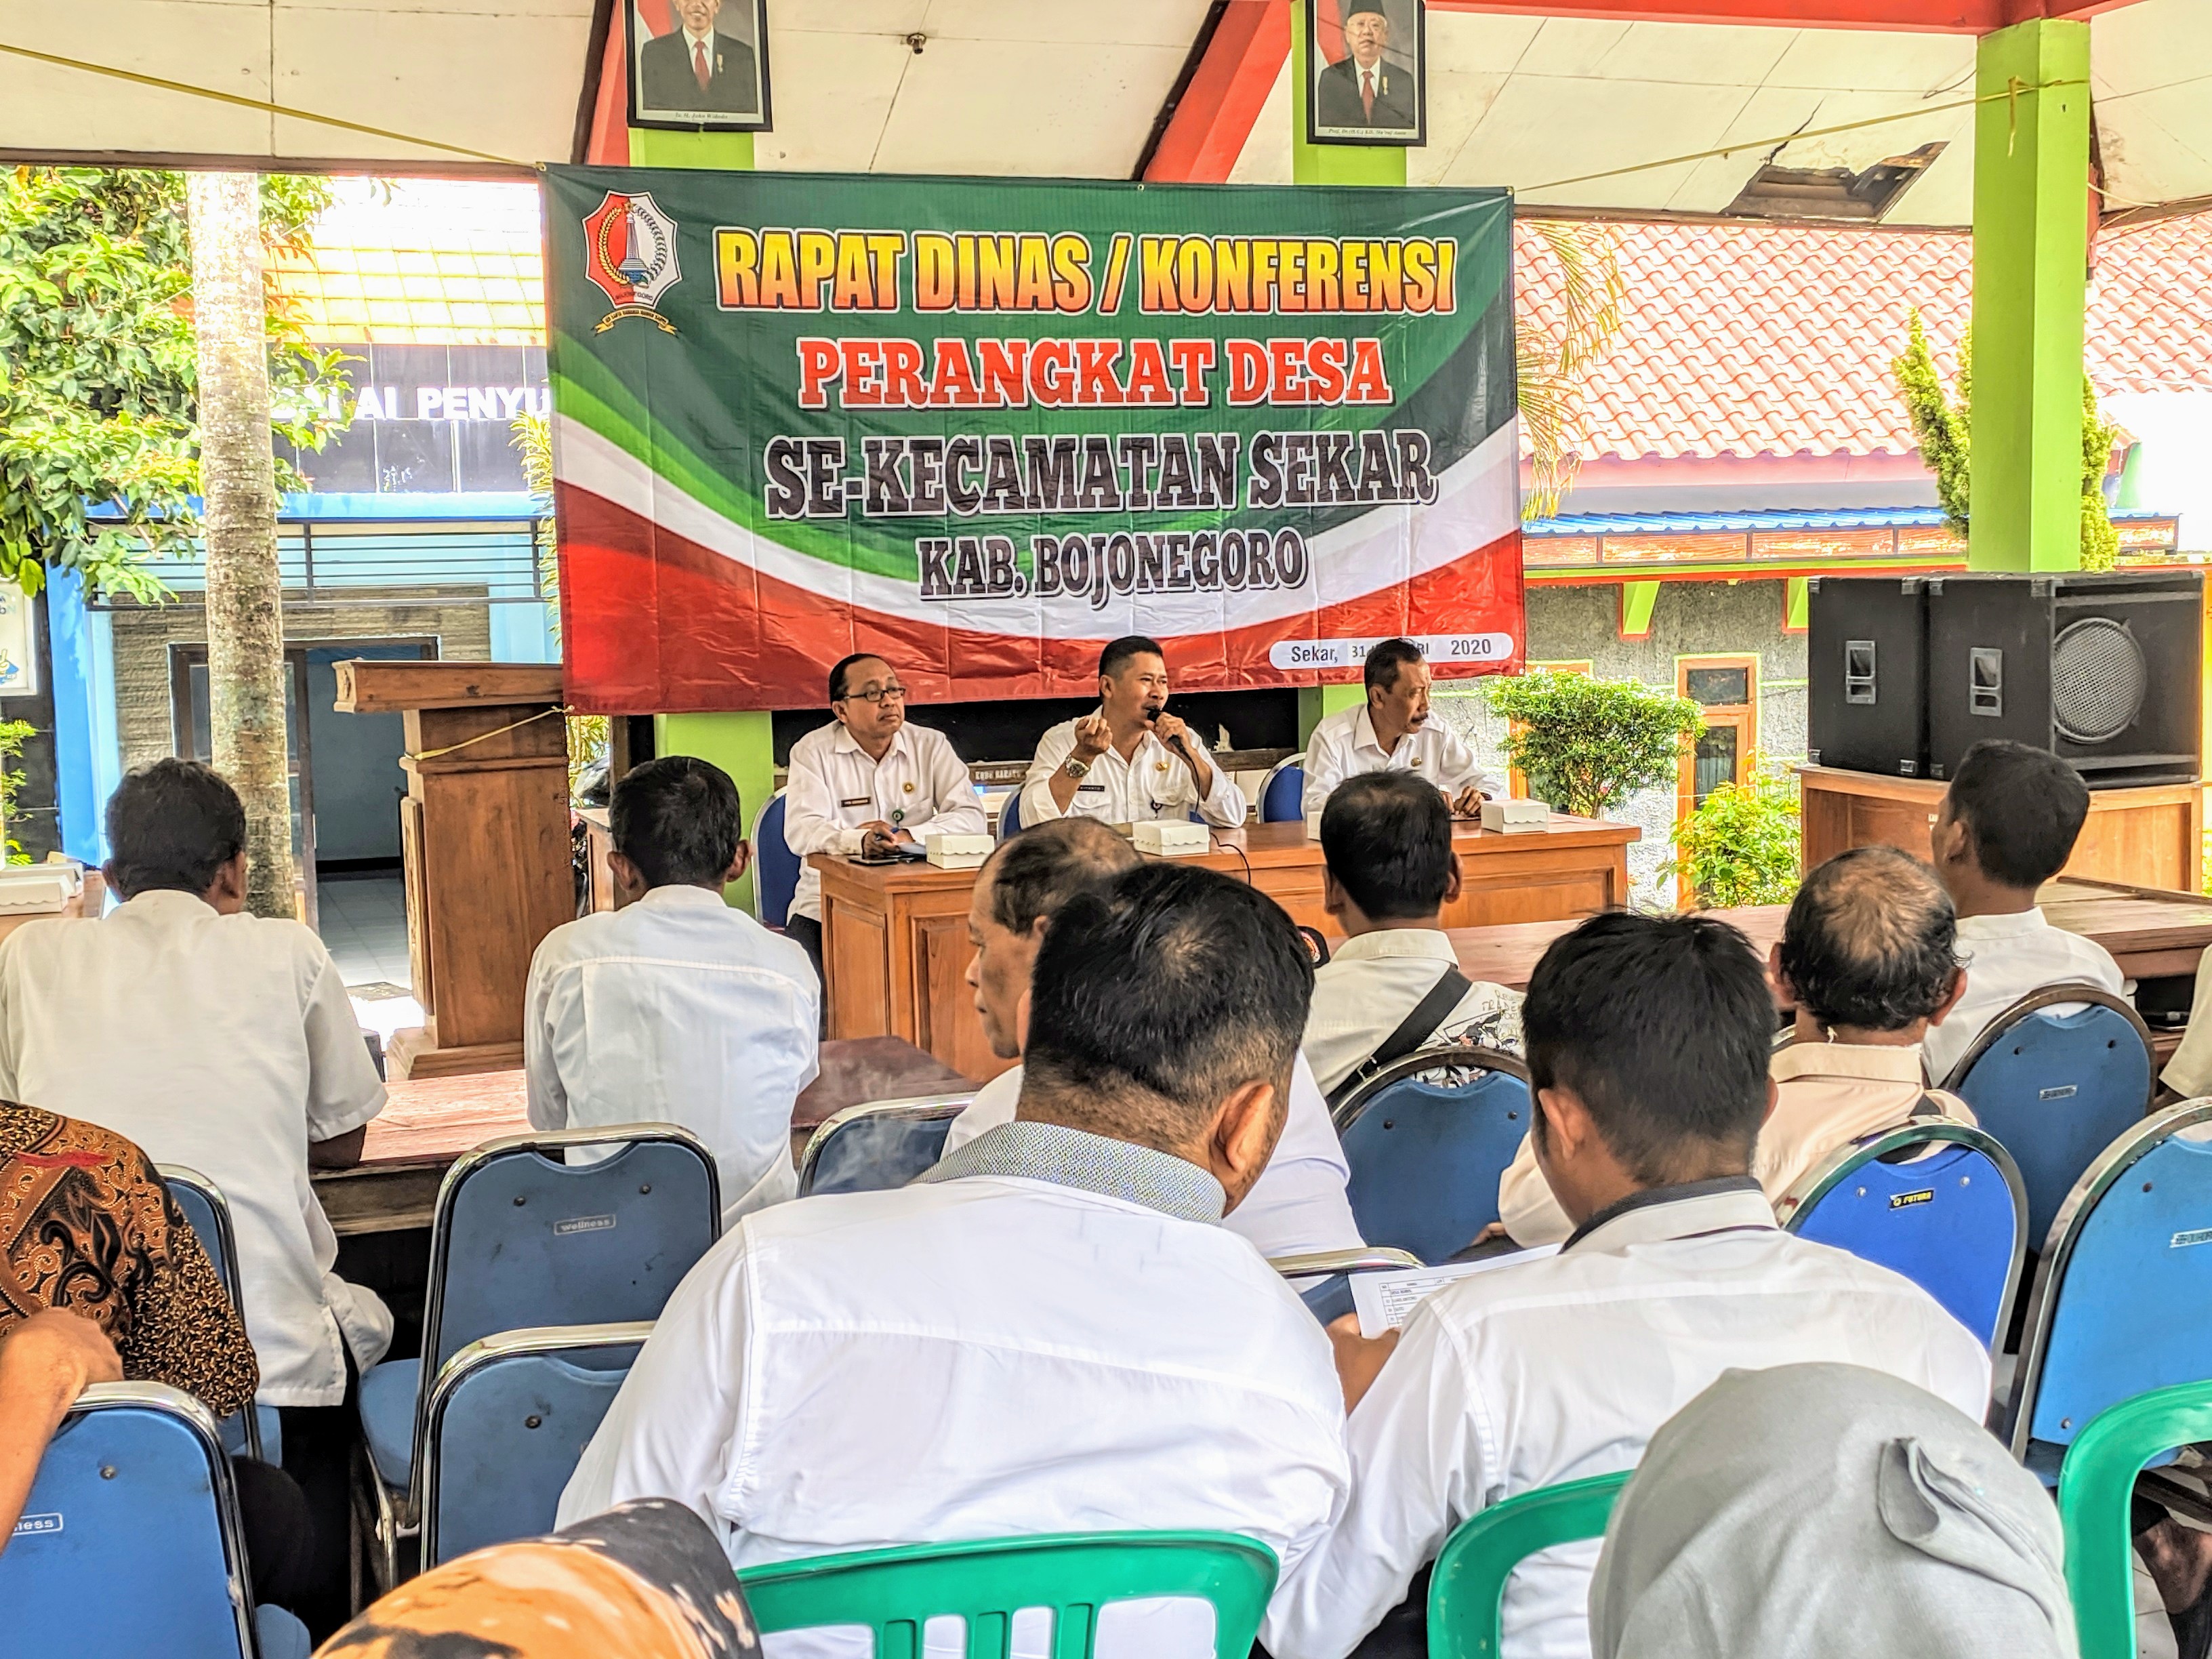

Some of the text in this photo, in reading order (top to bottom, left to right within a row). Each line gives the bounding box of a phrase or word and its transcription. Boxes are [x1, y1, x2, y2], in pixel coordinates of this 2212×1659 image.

[713, 227, 1458, 315] RAPAT DINAS / KONFERENSI
[798, 337, 1395, 409] PERANGKAT DESA
[764, 428, 1439, 519] SE-KECAMATAN SEKAR
[916, 527, 1309, 611] KAB. BOJONEGORO
[1291, 645, 1338, 663] Sekar,
[1352, 645, 1366, 657] 31
[1451, 638, 1491, 655] 2020
